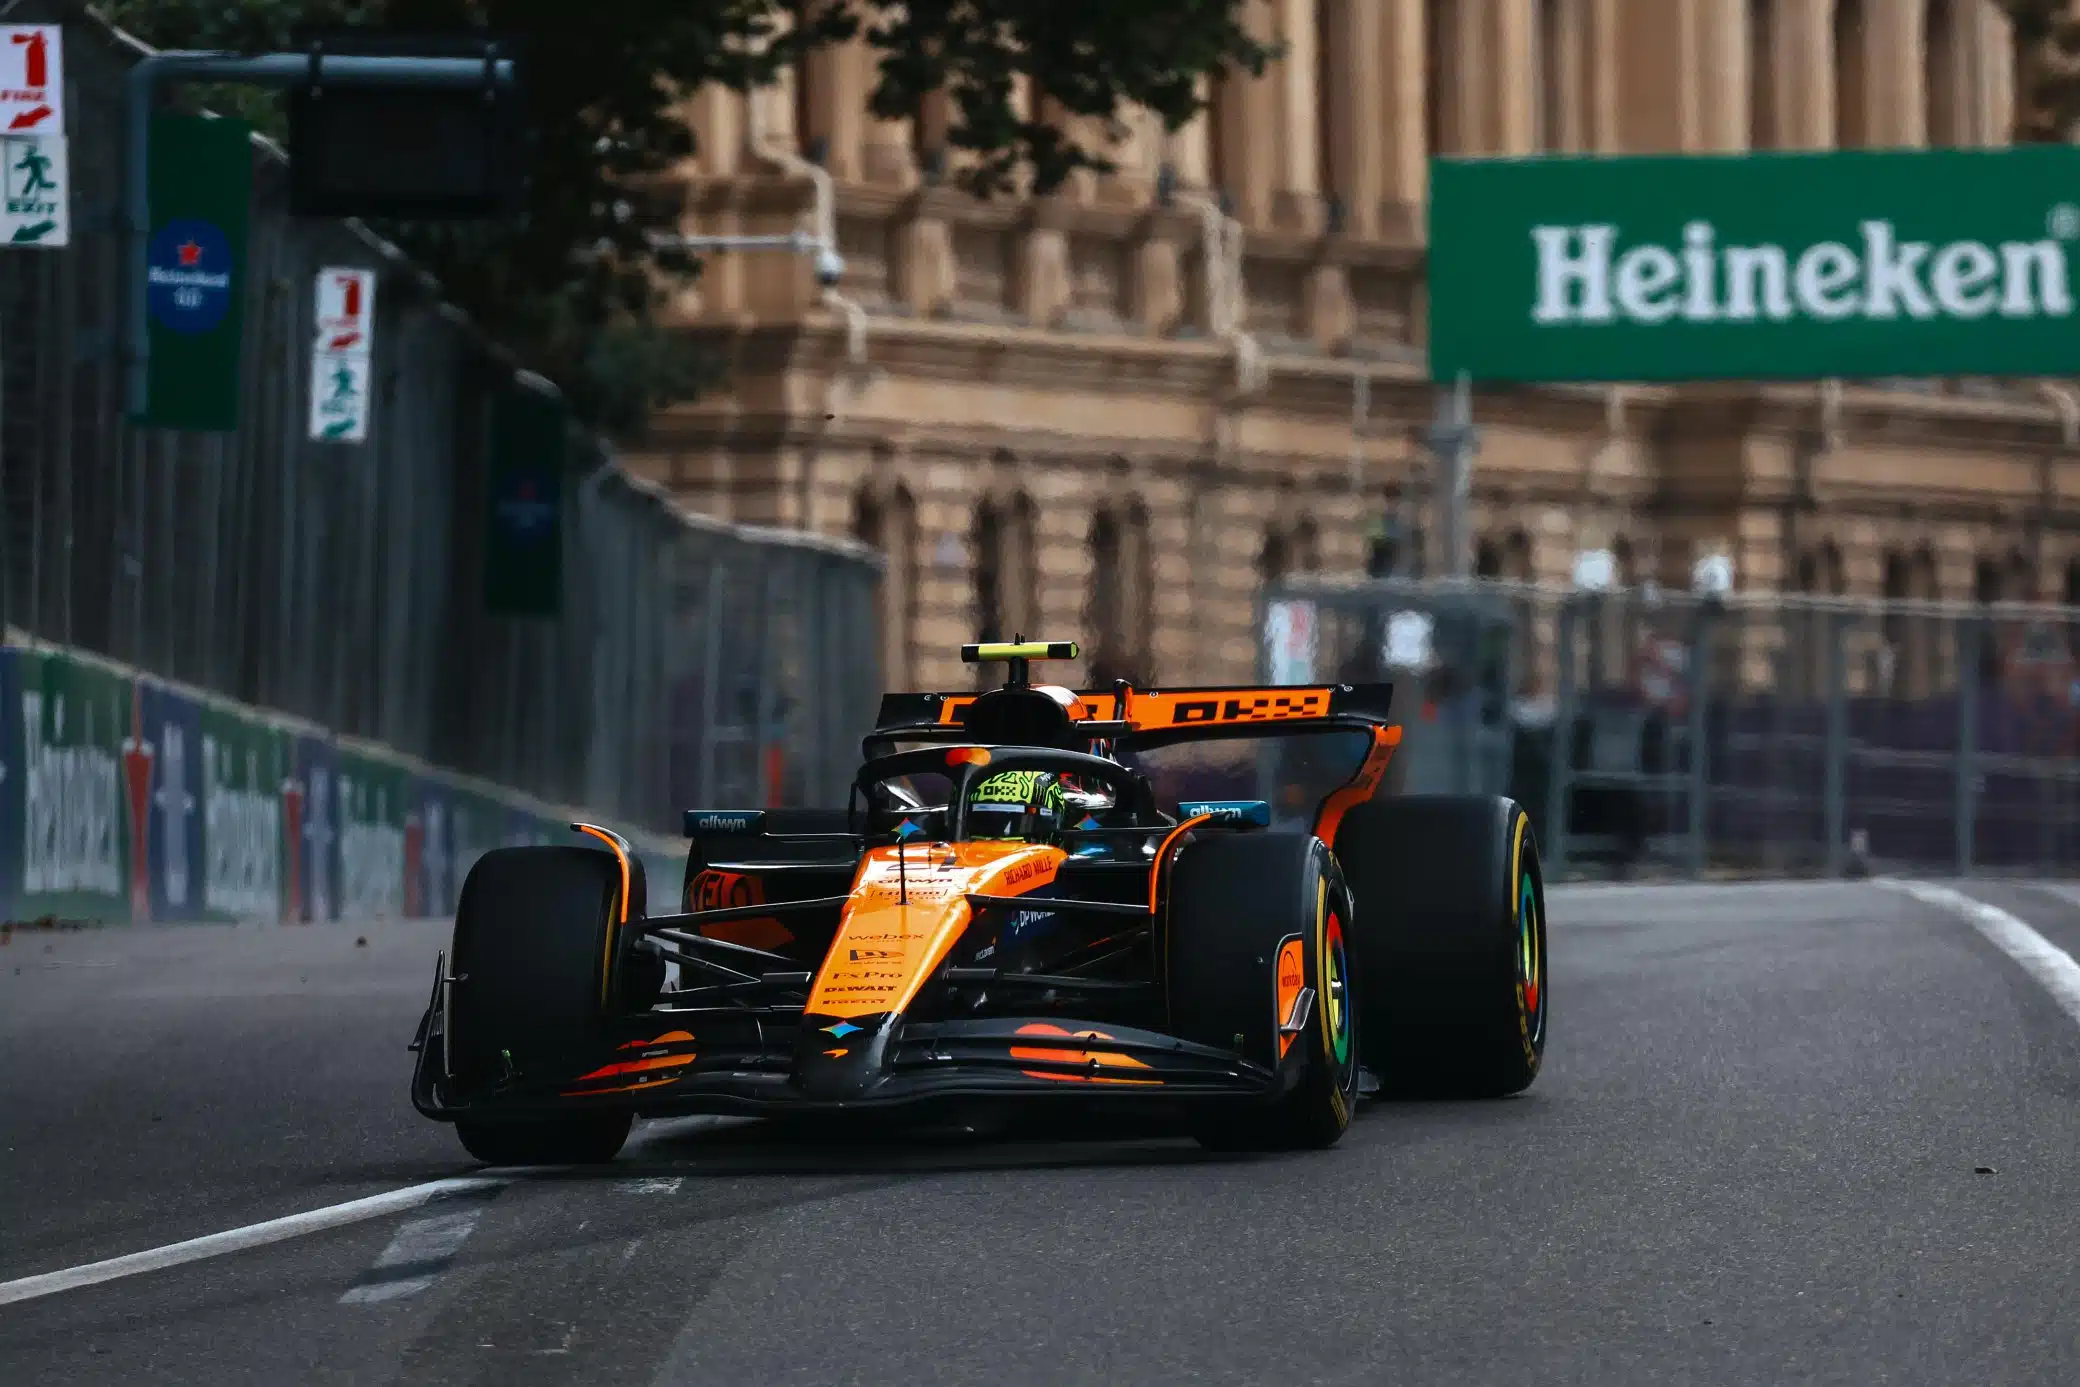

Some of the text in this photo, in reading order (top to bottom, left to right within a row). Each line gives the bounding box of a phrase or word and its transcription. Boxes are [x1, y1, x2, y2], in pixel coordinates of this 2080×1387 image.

[1531, 219, 2074, 323] Heineken
[983, 785, 1017, 797] OKX
[699, 814, 747, 832] allwyn
[1004, 855, 1053, 886] RICHARD MILLE
[848, 933, 925, 941] webex
